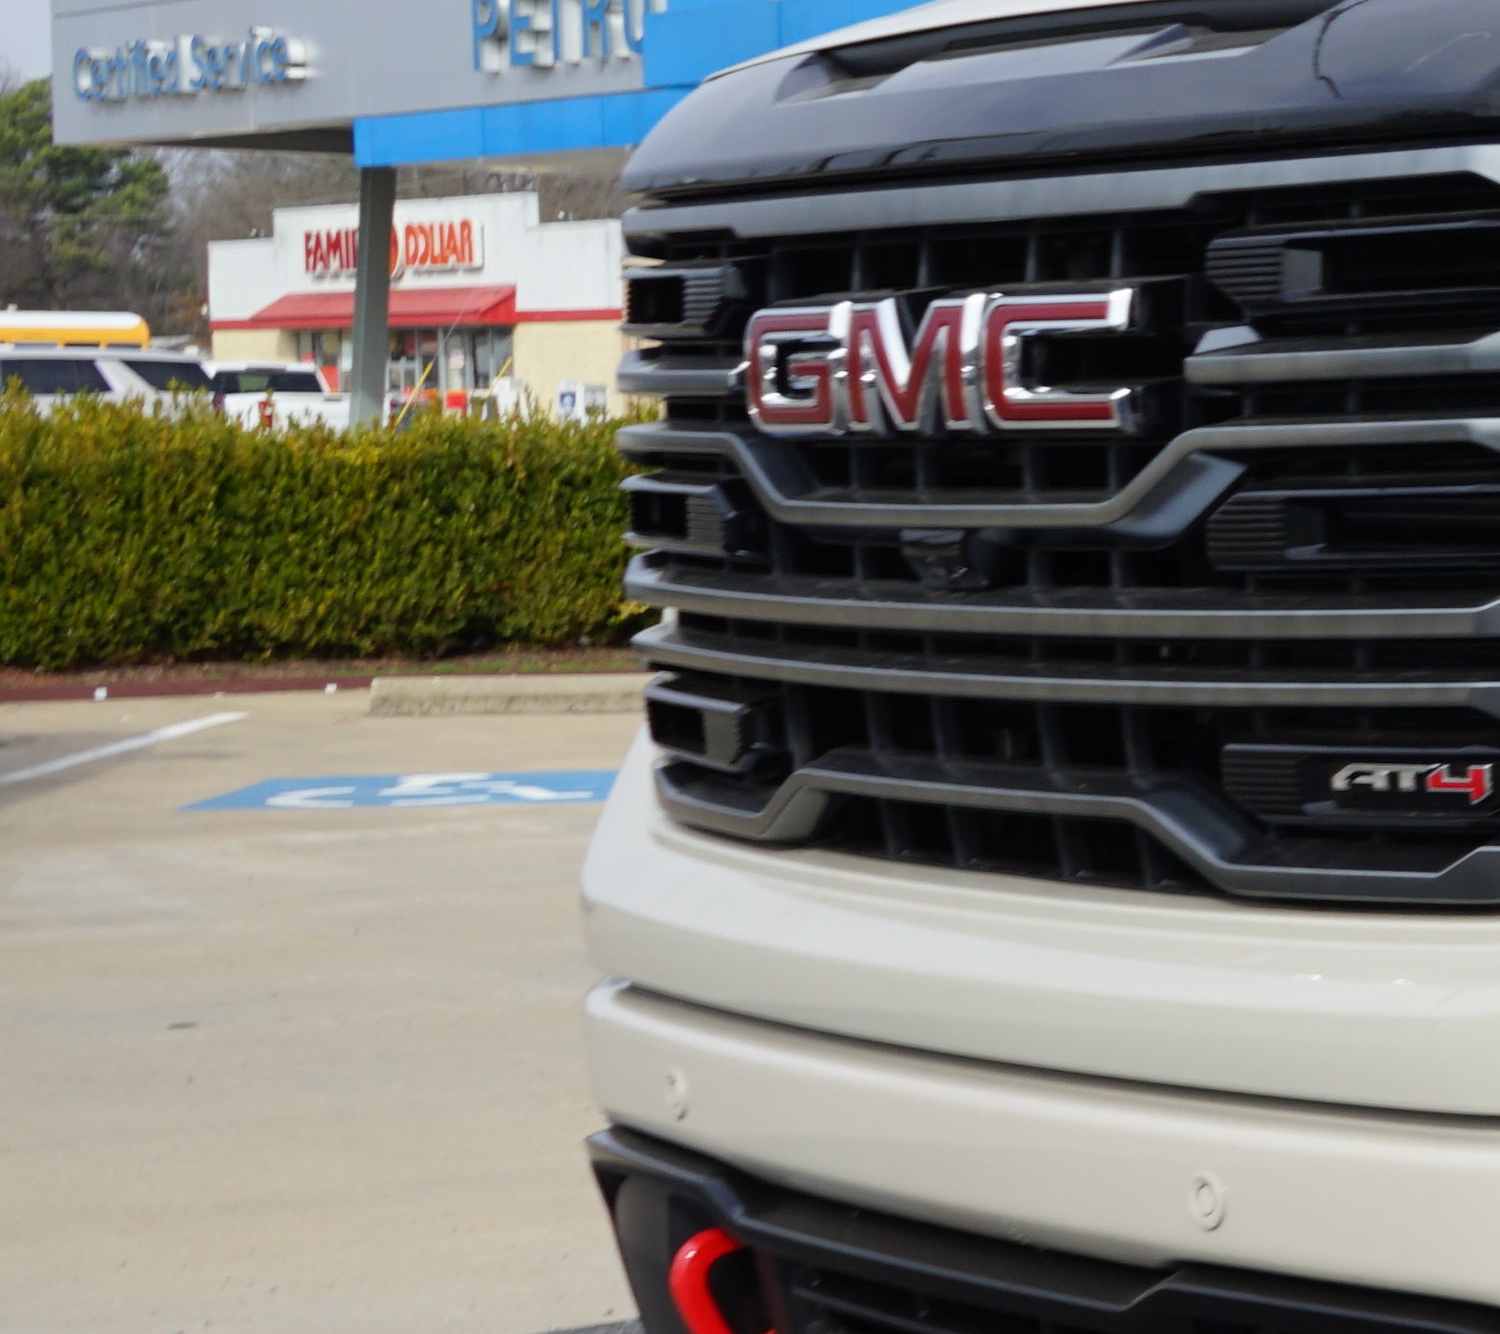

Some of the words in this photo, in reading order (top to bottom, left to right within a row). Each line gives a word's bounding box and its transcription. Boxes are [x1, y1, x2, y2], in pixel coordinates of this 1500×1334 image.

[74, 38, 184, 101] Certified
[190, 27, 304, 90] Service
[304, 229, 358, 271] FAMI
[405, 219, 473, 265] DOLLAR
[745, 289, 1134, 435] GMC
[1330, 763, 1494, 805] AT4
